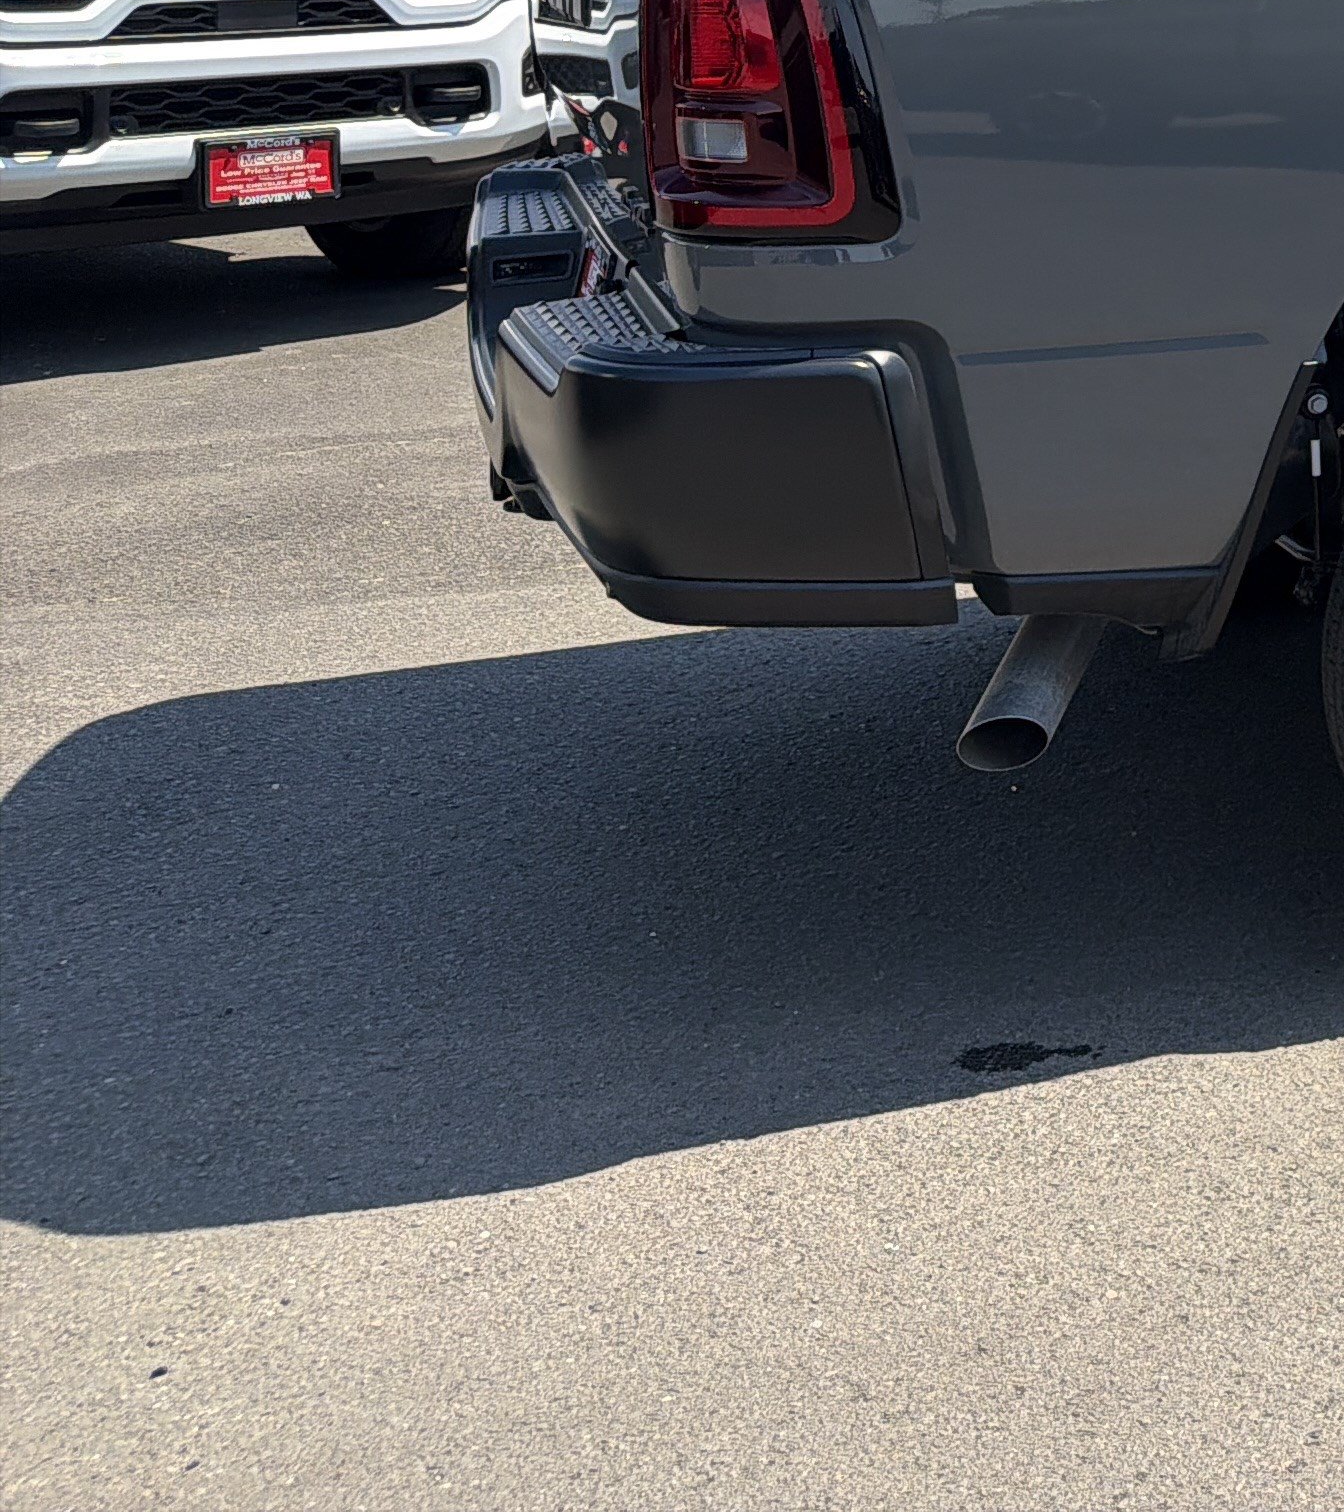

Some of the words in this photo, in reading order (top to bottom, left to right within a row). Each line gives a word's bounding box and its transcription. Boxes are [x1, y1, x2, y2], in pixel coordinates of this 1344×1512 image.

[246, 137, 300, 149] McCord's
[241, 150, 302, 166] McCord's
[220, 169, 242, 178] Low
[244, 167, 270, 175] Price
[238, 192, 293, 206] LONGVIEW
[295, 191, 312, 200] WA
